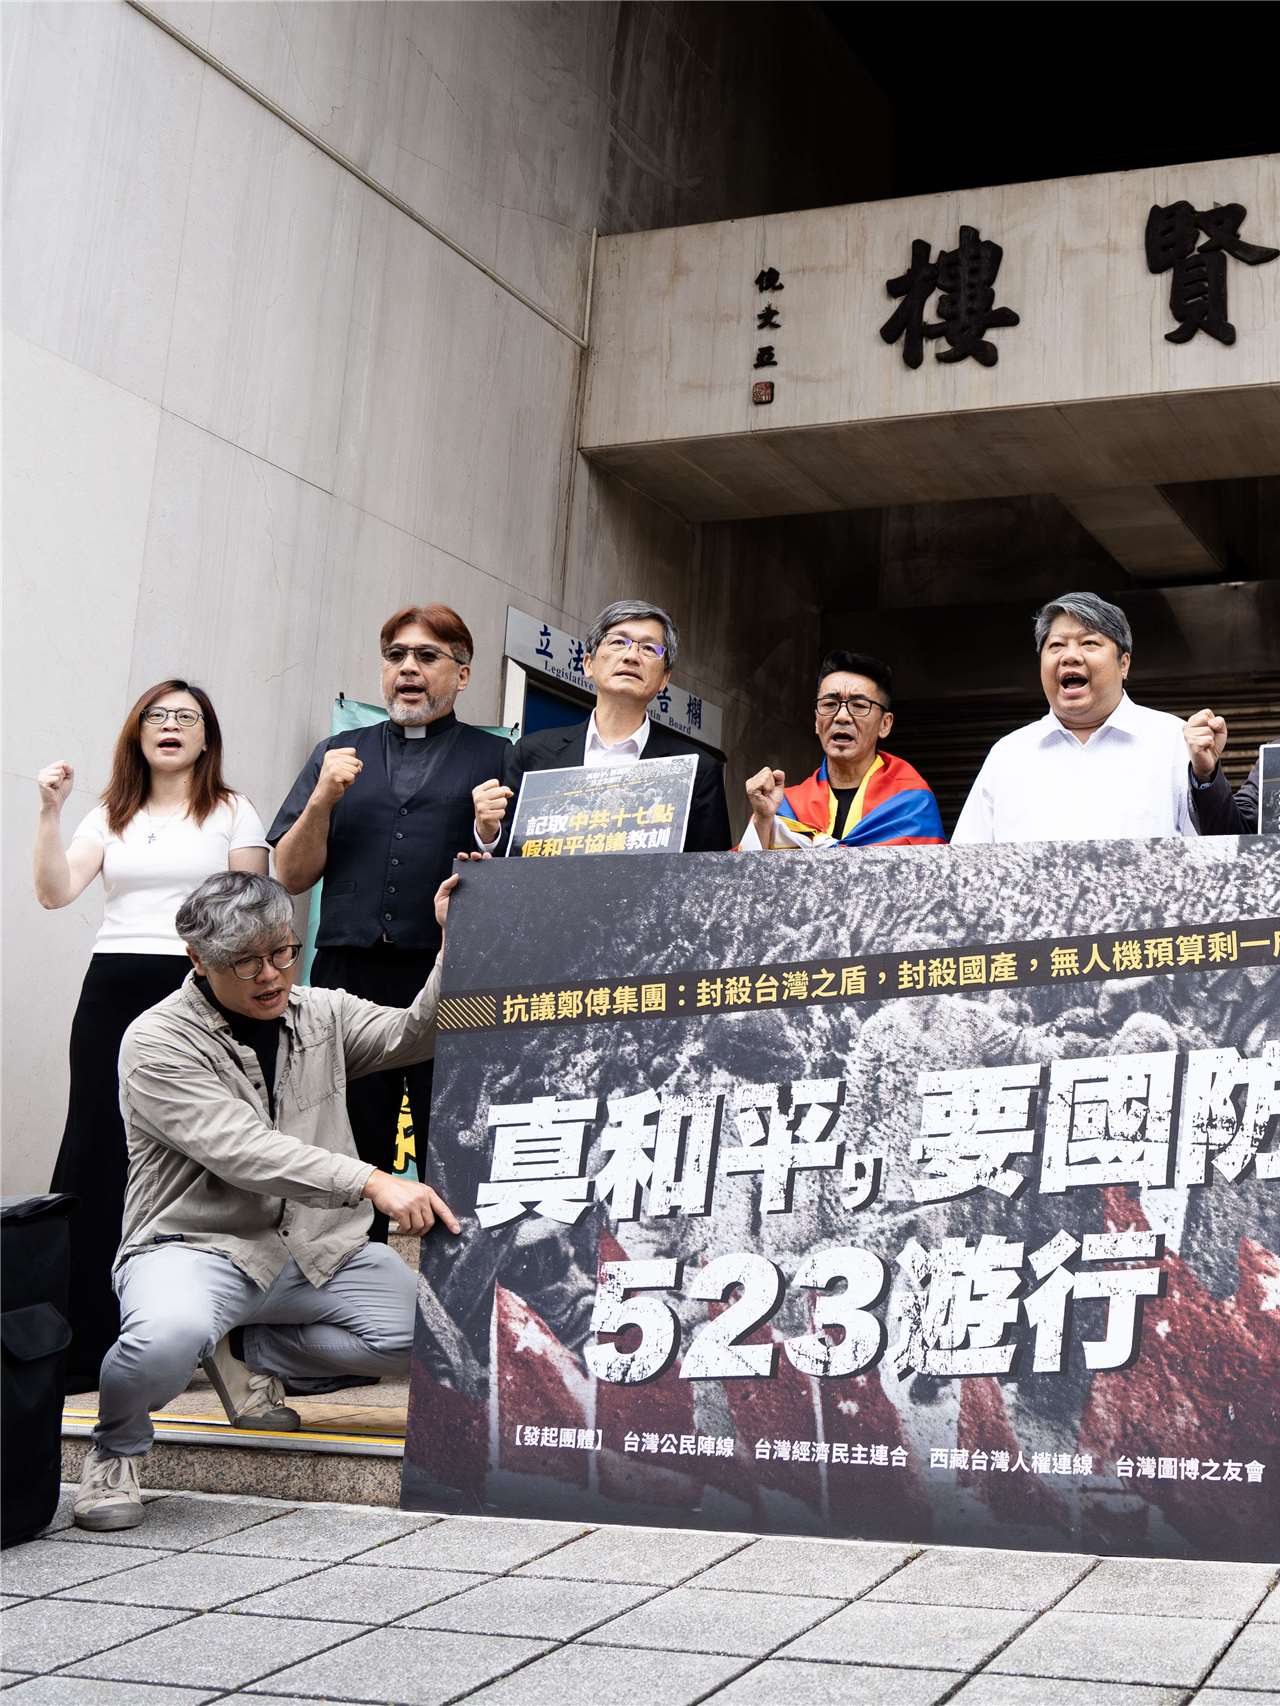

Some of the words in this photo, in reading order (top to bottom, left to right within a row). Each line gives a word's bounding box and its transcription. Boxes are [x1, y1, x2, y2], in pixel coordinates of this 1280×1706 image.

[754, 267, 784, 369] 倪文亞
[544, 660, 594, 691] Legislative
[669, 716, 692, 734] Board
[526, 802, 676, 836] 記取中共十七點
[521, 827, 672, 857] 假和平協議教訓
[584, 1230, 1163, 1385] 523遊行
[623, 1431, 735, 1459] 台灣公民陣線
[754, 1438, 909, 1468] 台灣經濟民主連合
[929, 1447, 1094, 1476] 西藏台灣人權連線
[1115, 1455, 1266, 1485] 台灣圖博之友會
